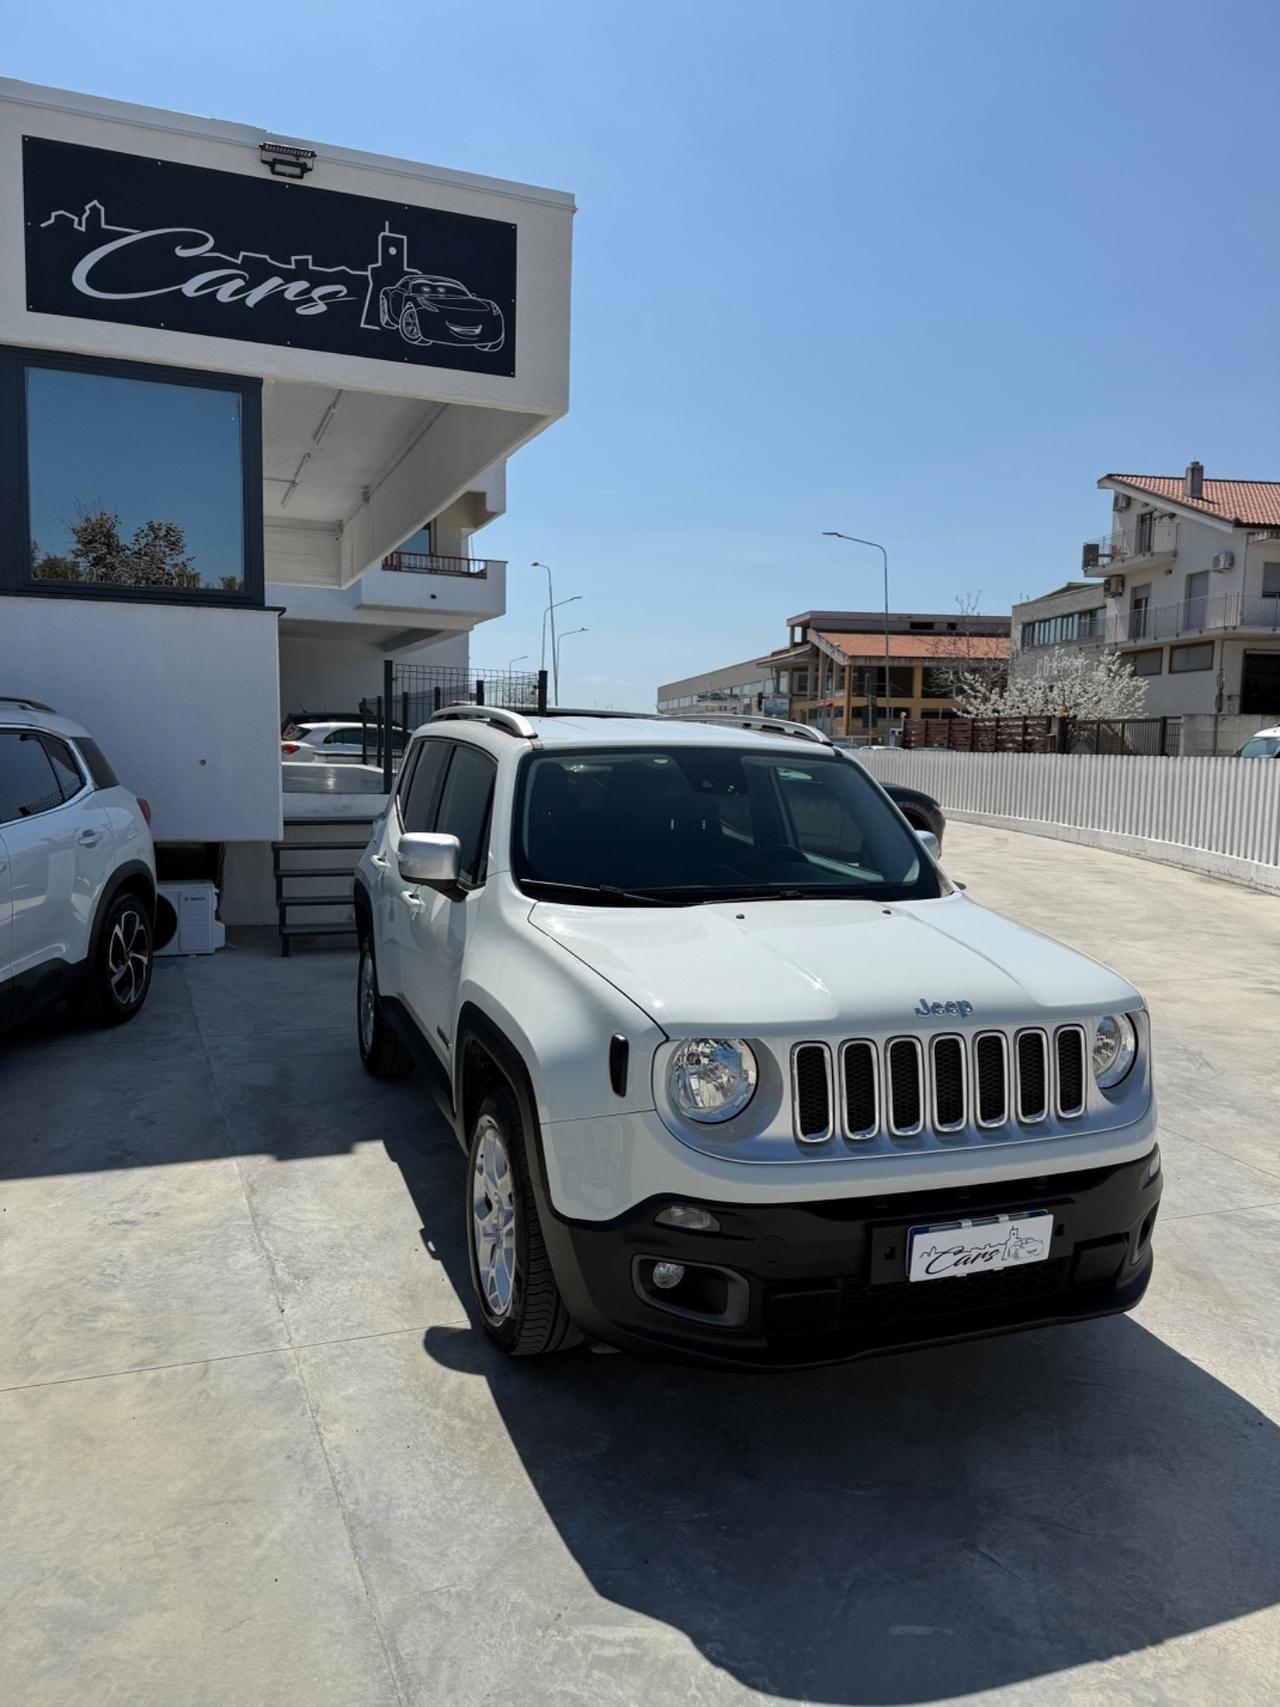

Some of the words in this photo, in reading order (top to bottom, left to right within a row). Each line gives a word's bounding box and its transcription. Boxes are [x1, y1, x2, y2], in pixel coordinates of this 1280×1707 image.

[72, 228, 358, 315] Cars
[914, 998, 973, 1018] Jeep
[925, 1245, 1000, 1275] Cars
